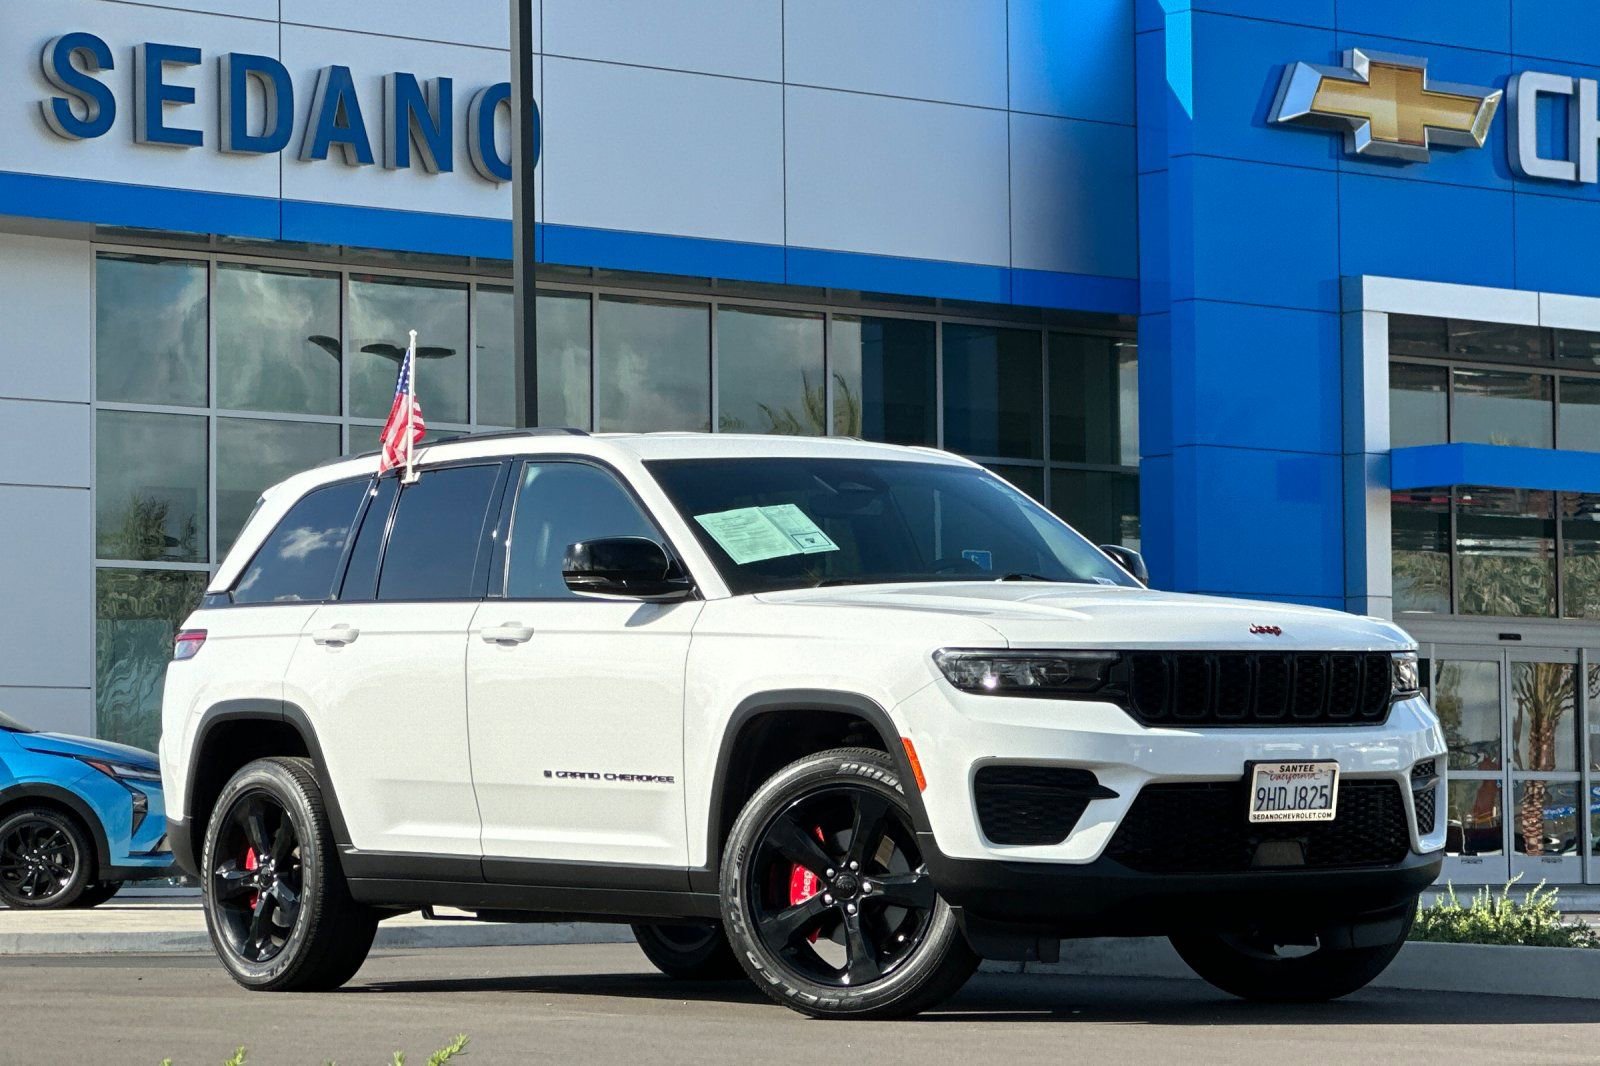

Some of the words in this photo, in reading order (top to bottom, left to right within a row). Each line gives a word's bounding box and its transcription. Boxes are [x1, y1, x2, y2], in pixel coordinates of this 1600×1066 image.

[40, 31, 542, 185] SEDANO
[1249, 622, 1282, 637] Jeep
[1279, 764, 1315, 773] SANTEE
[555, 770, 600, 780] GRAND
[603, 773, 675, 784] CHEROKEE
[1256, 784, 1329, 812] 9HDJ825
[1252, 811, 1332, 821] SEDANOCHEVROLET.COM
